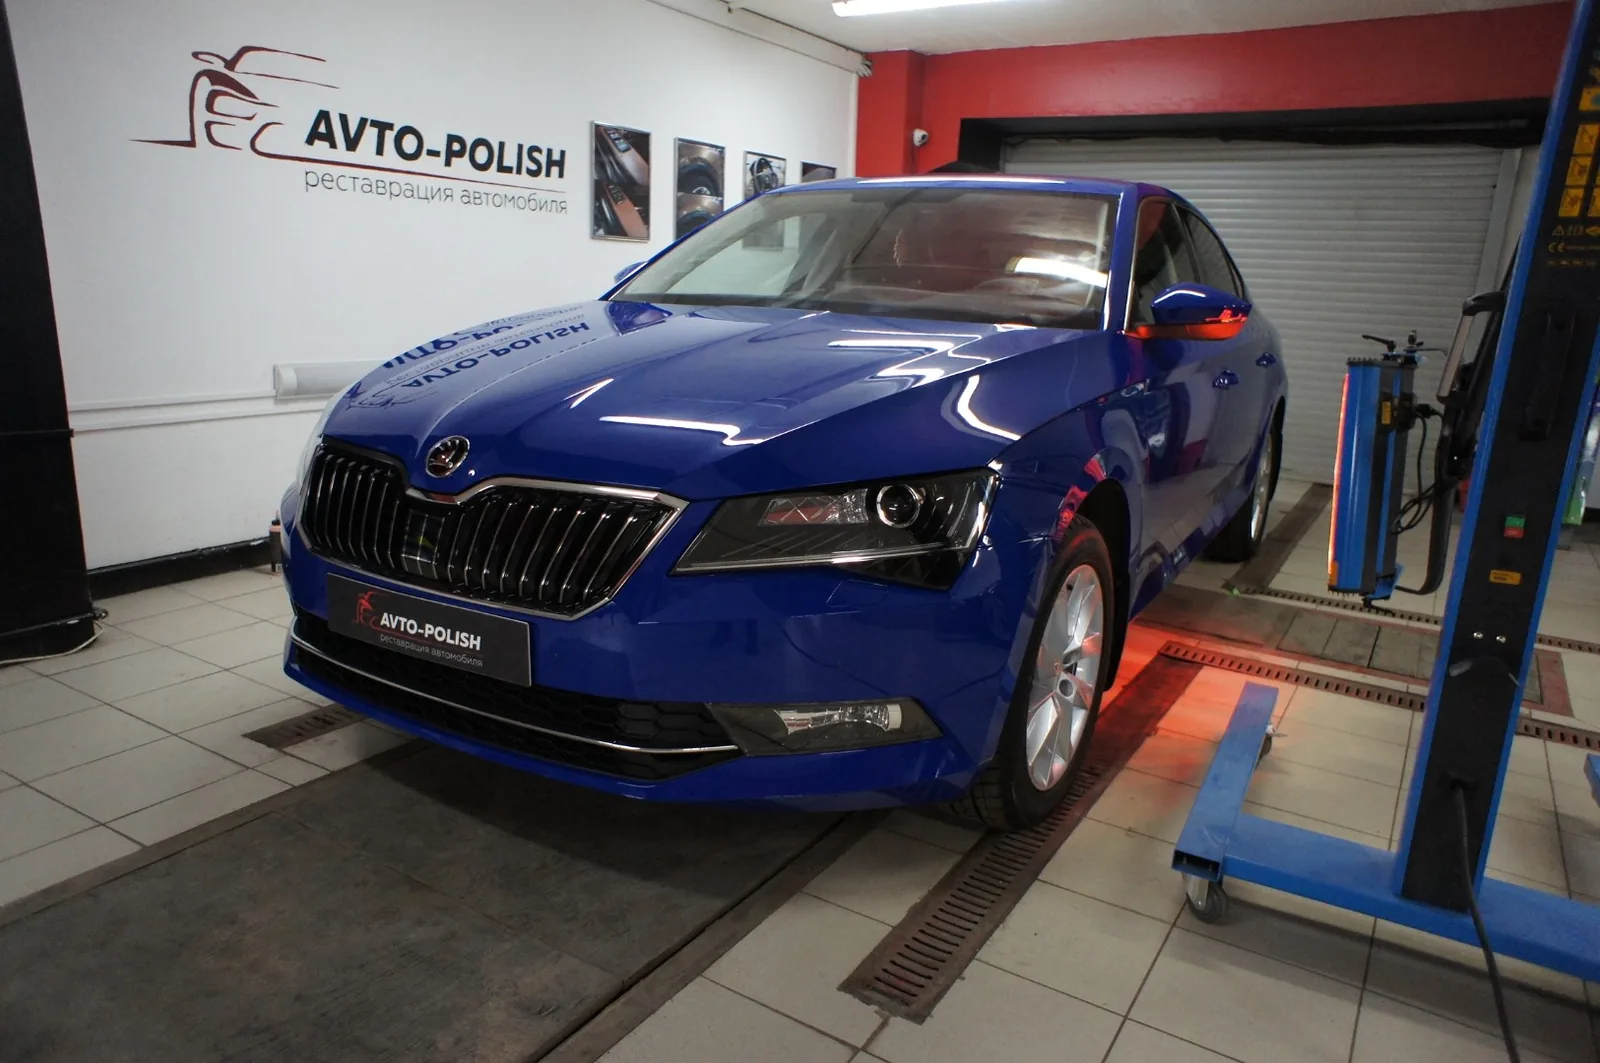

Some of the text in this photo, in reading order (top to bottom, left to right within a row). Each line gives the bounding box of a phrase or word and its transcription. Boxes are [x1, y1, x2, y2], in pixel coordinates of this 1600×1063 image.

[304, 109, 566, 178] AVTO-POLISH
[305, 169, 568, 214] реставрация автомобиля
[379, 634, 483, 667] реставрация автомобиля
